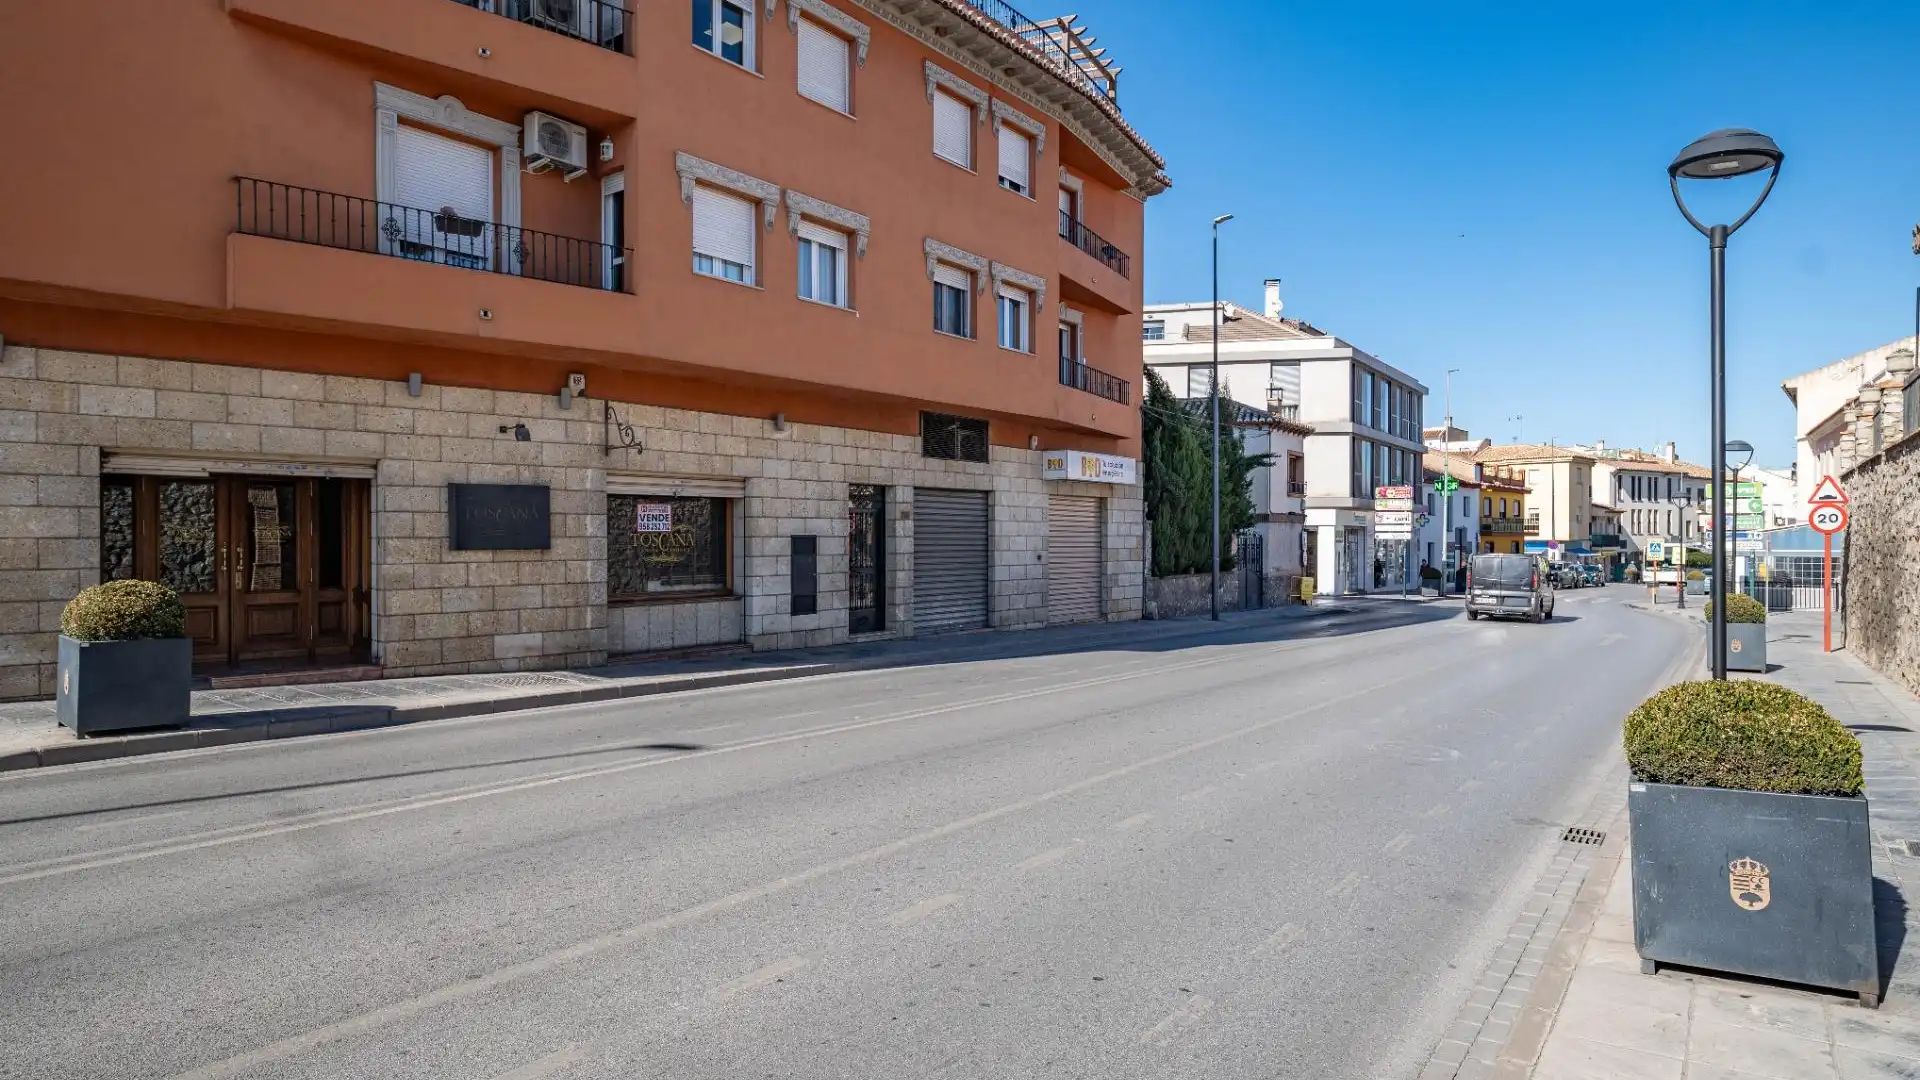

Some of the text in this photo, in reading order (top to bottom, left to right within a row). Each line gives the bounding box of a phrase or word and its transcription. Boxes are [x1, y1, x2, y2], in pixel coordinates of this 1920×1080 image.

[639, 513, 670, 522] VENDE
[1816, 513, 1839, 524] 20
[629, 532, 694, 552] TOSCANA
